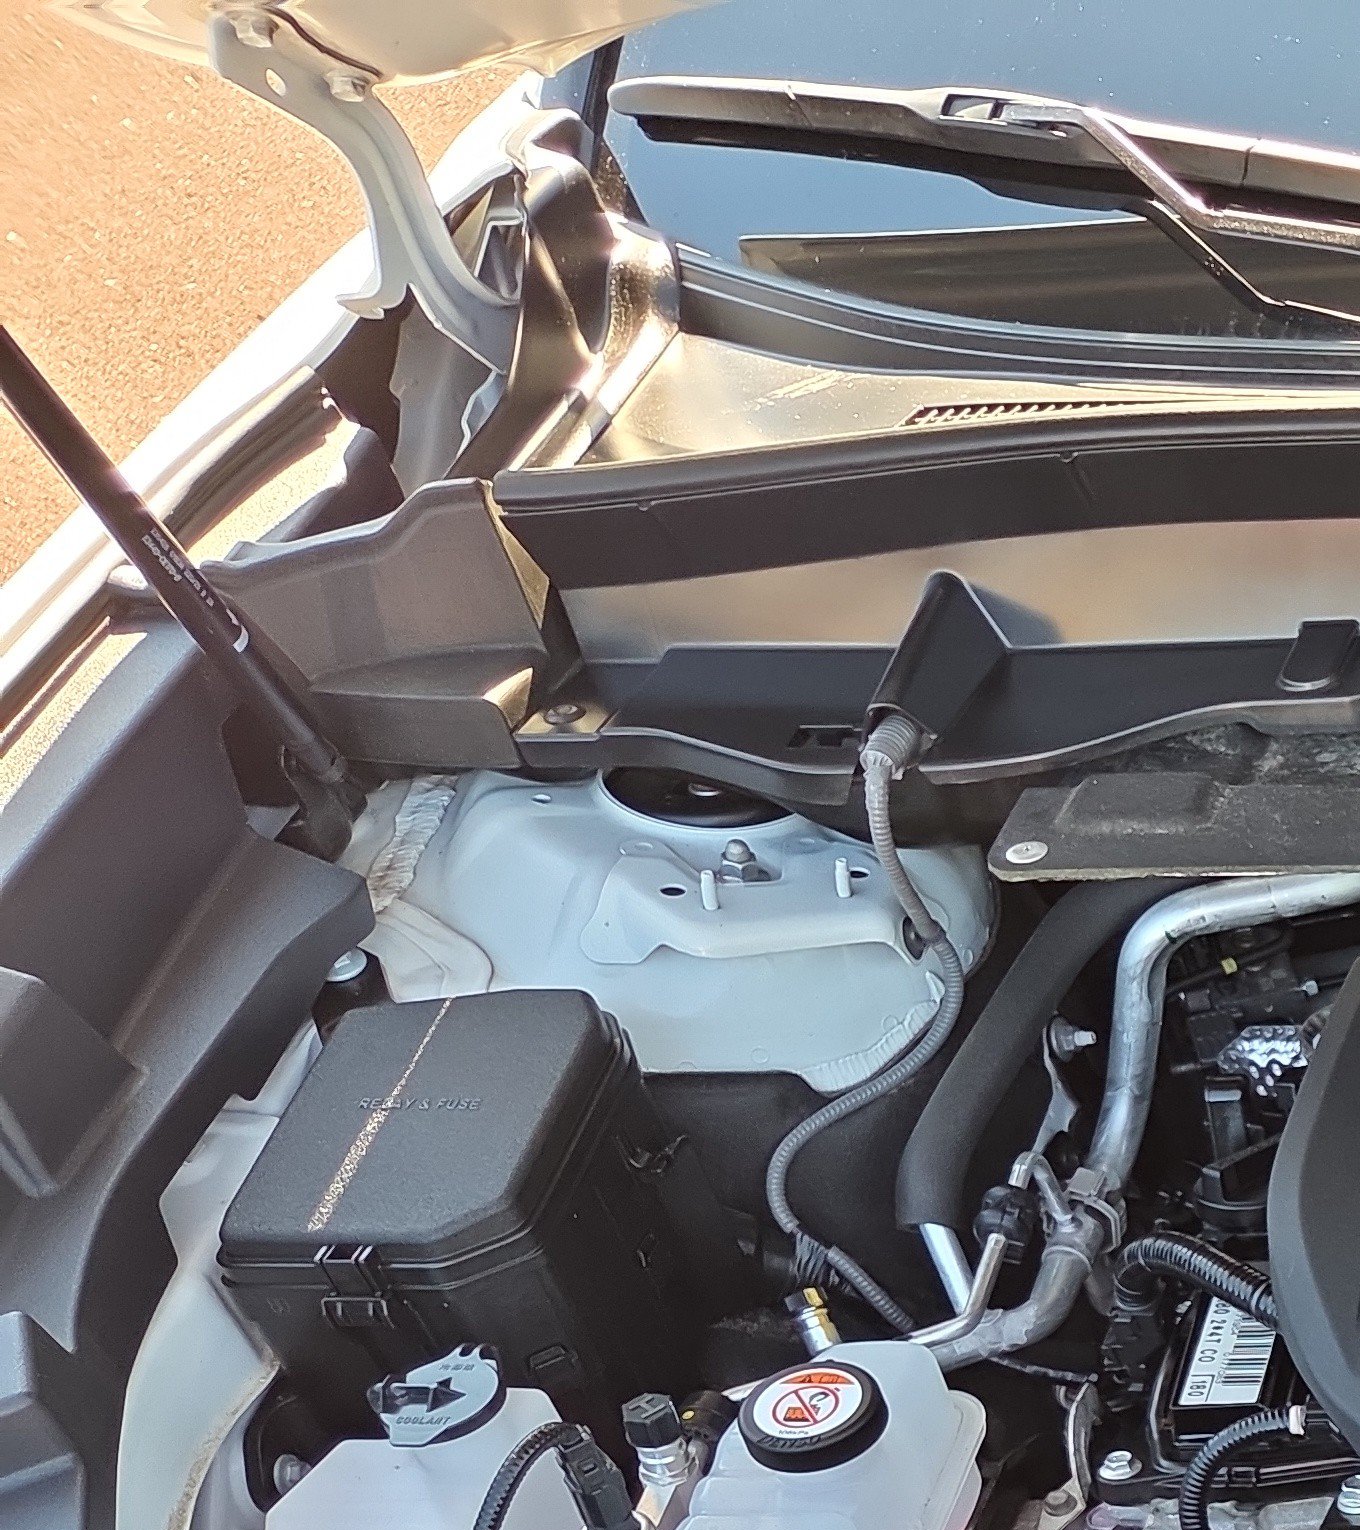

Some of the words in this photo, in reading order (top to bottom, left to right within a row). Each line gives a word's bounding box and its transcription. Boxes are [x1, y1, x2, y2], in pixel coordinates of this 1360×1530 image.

[419, 1098, 430, 1110] &
[436, 1097, 483, 1110] FUSE
[1187, 1379, 1207, 1398] 180
[395, 1415, 452, 1426] COOLANT
